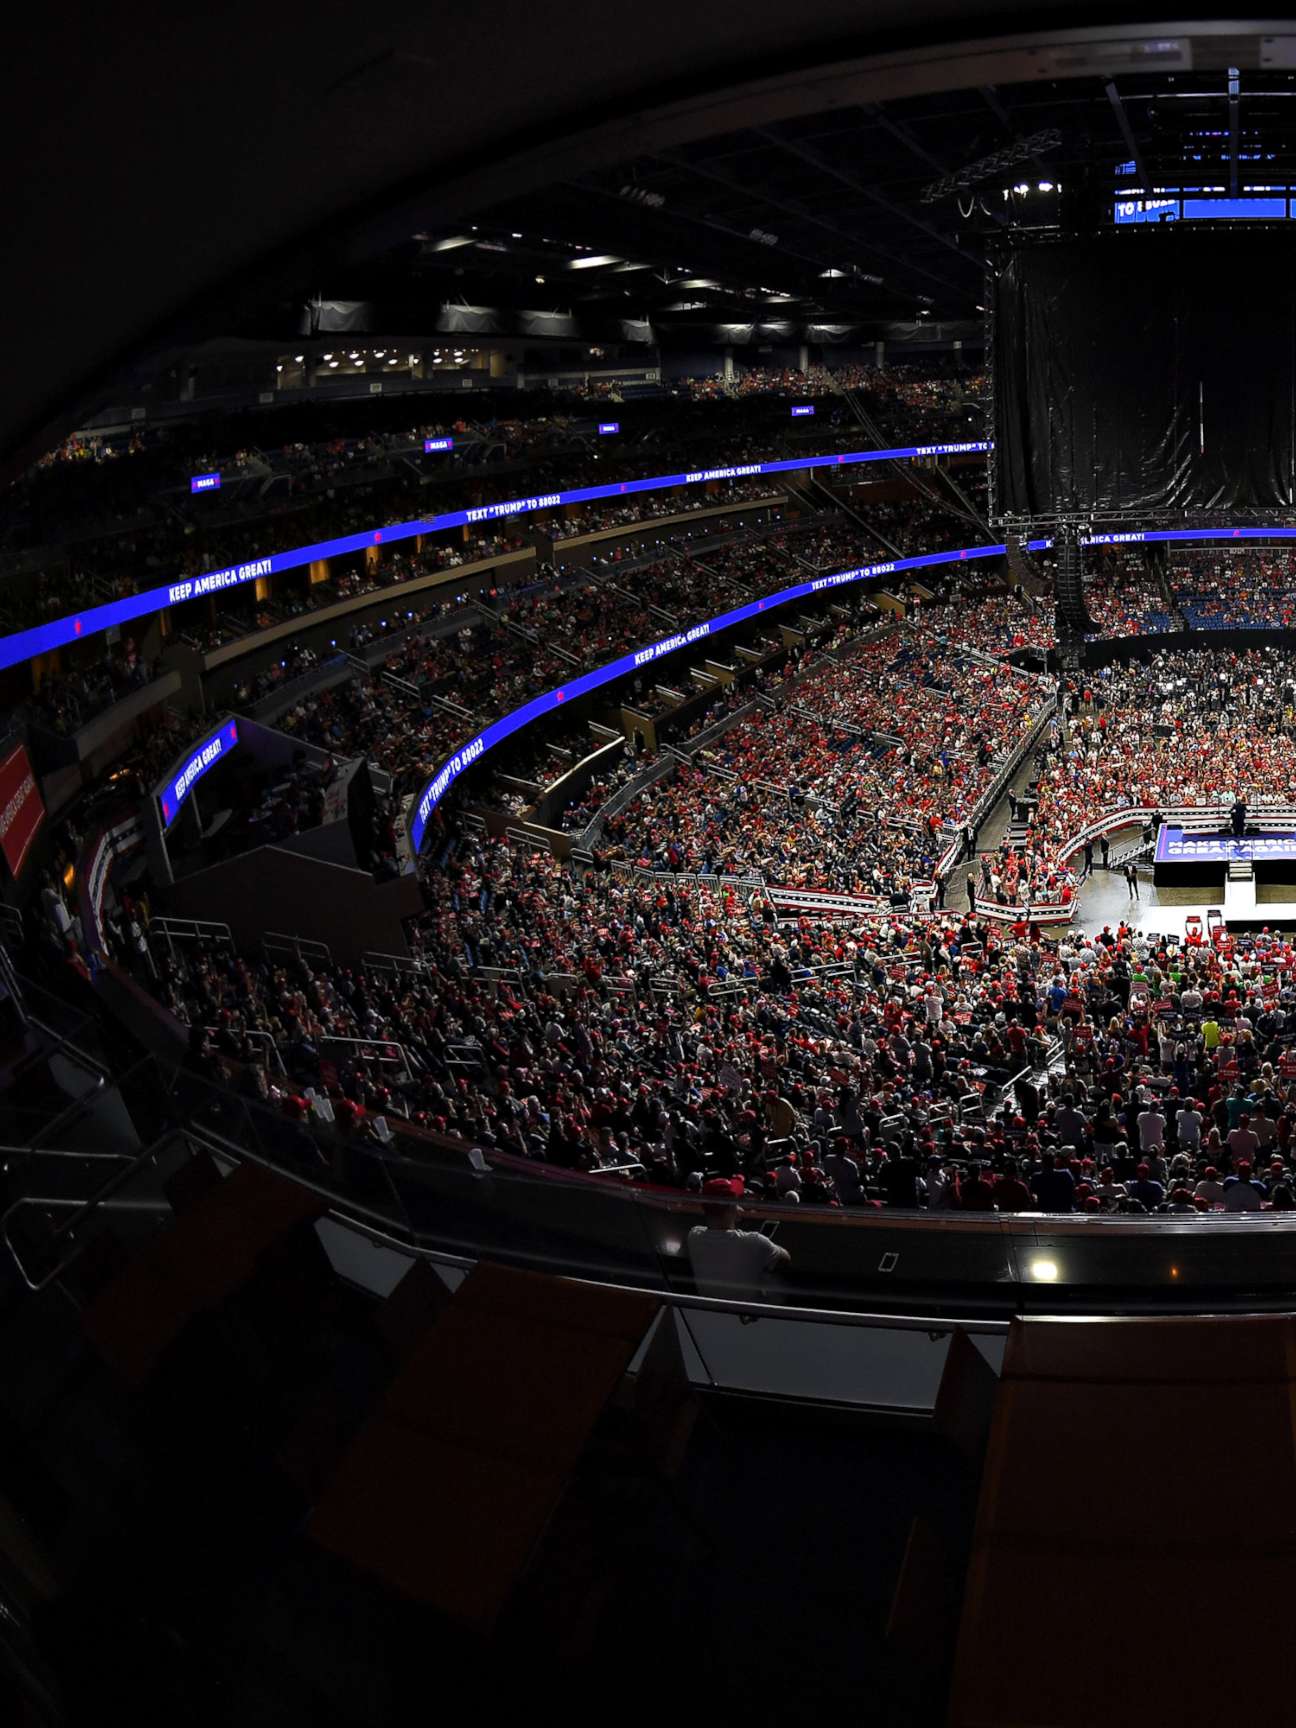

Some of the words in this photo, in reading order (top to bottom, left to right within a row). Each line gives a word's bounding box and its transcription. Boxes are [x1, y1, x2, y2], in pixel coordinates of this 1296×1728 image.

[1118, 202, 1134, 217] TO
[916, 447, 937, 455] TEXT
[197, 478, 215, 488] MAGA
[686, 473, 702, 483] KEEP
[704, 468, 736, 480] AMERICA
[466, 508, 488, 522] TEXT
[526, 499, 538, 510] TO
[538, 495, 561, 507] 88022
[168, 582, 192, 603] KEEP
[194, 569, 238, 595] AMERICA
[238, 559, 272, 580] GREAT!
[811, 578, 828, 591] TEXT
[859, 569, 870, 577] TO
[871, 563, 895, 575] 88022
[634, 648, 654, 665] KEEP
[655, 636, 687, 656] AMERICA
[686, 623, 710, 641] GREAT!
[450, 757, 461, 775] TO
[461, 738, 484, 766] 88022
[183, 755, 204, 787] AMERICA
[1167, 847, 1235, 855] GREAT
